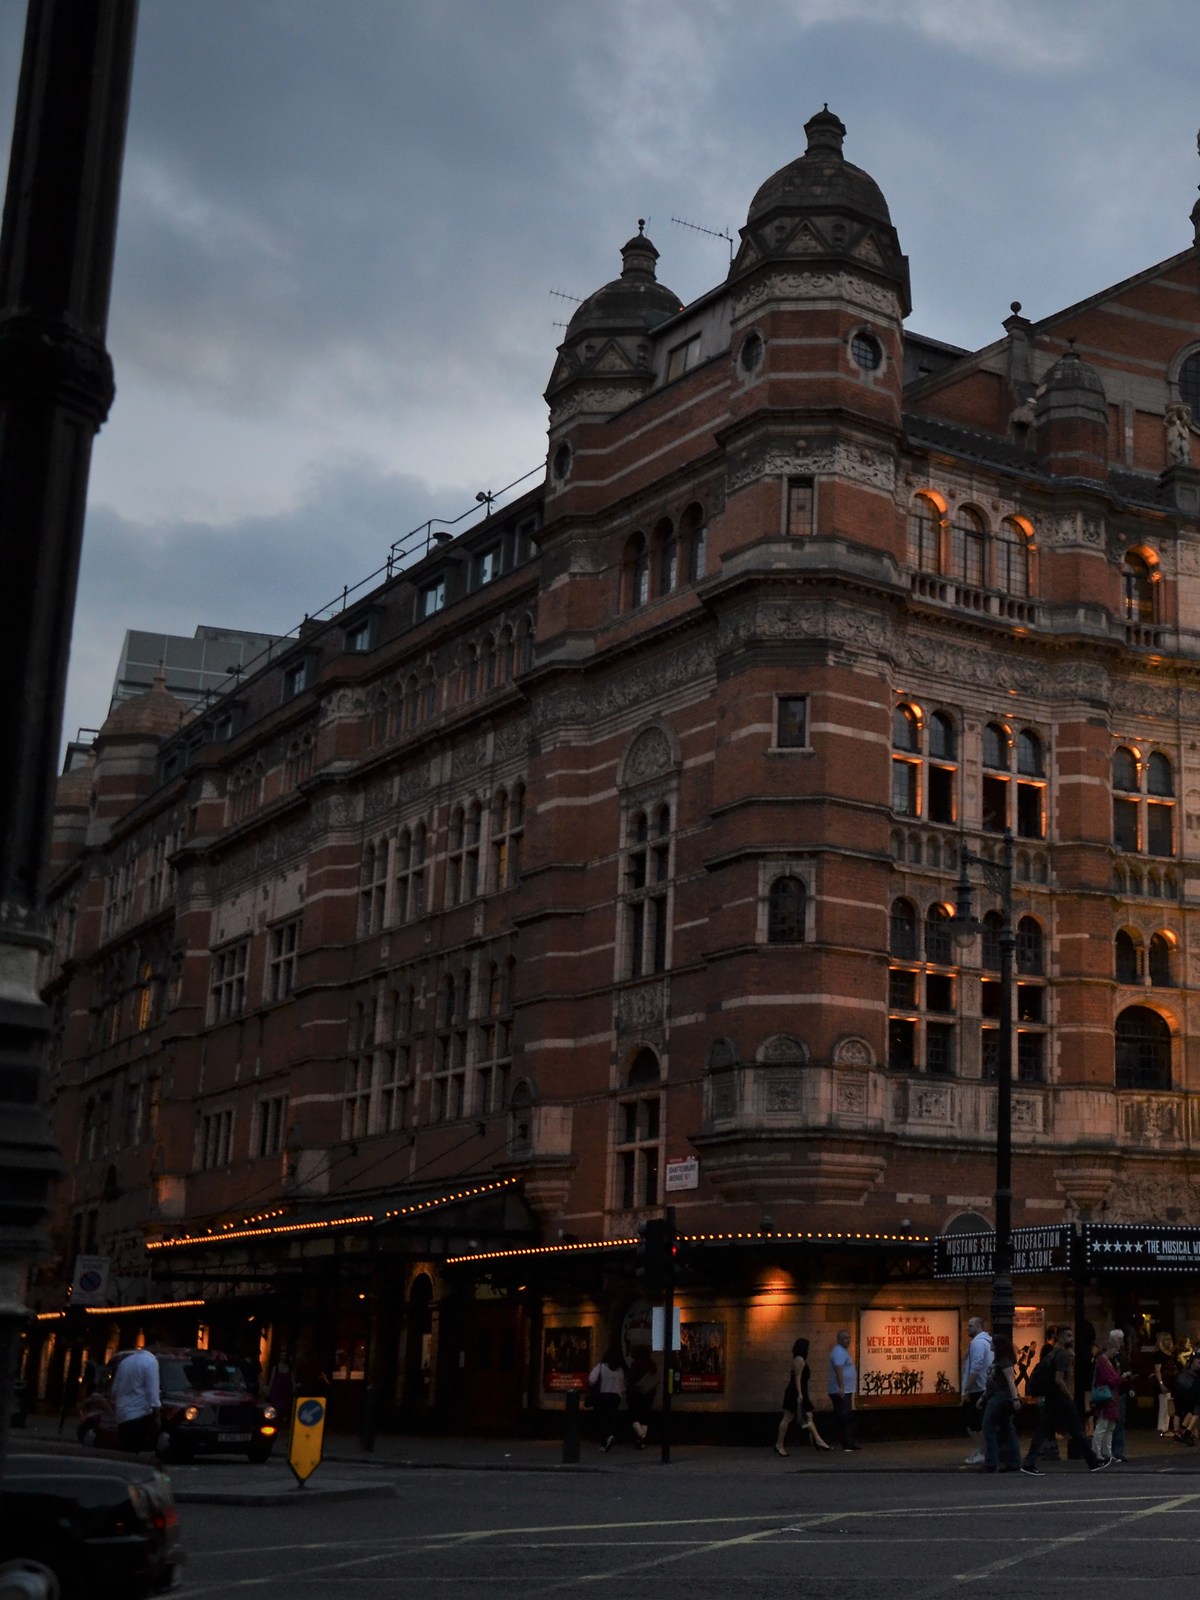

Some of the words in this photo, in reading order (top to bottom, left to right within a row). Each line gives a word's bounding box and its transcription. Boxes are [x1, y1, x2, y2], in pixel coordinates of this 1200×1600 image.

[946, 1238, 978, 1255] MUSTANG
[981, 1236, 997, 1252] SALL
[1161, 1240, 1190, 1254] MUSICAL
[952, 1256, 969, 1272] PAPA
[972, 1254, 985, 1271] WAS
[988, 1254, 993, 1270] A
[1029, 1250, 1053, 1267] STONE
[902, 1325, 931, 1335] MUSICAL
[867, 1336, 886, 1346] WE'VE
[888, 1336, 905, 1346] BEEN
[907, 1336, 935, 1346] WAITING
[937, 1336, 950, 1346] FOR
